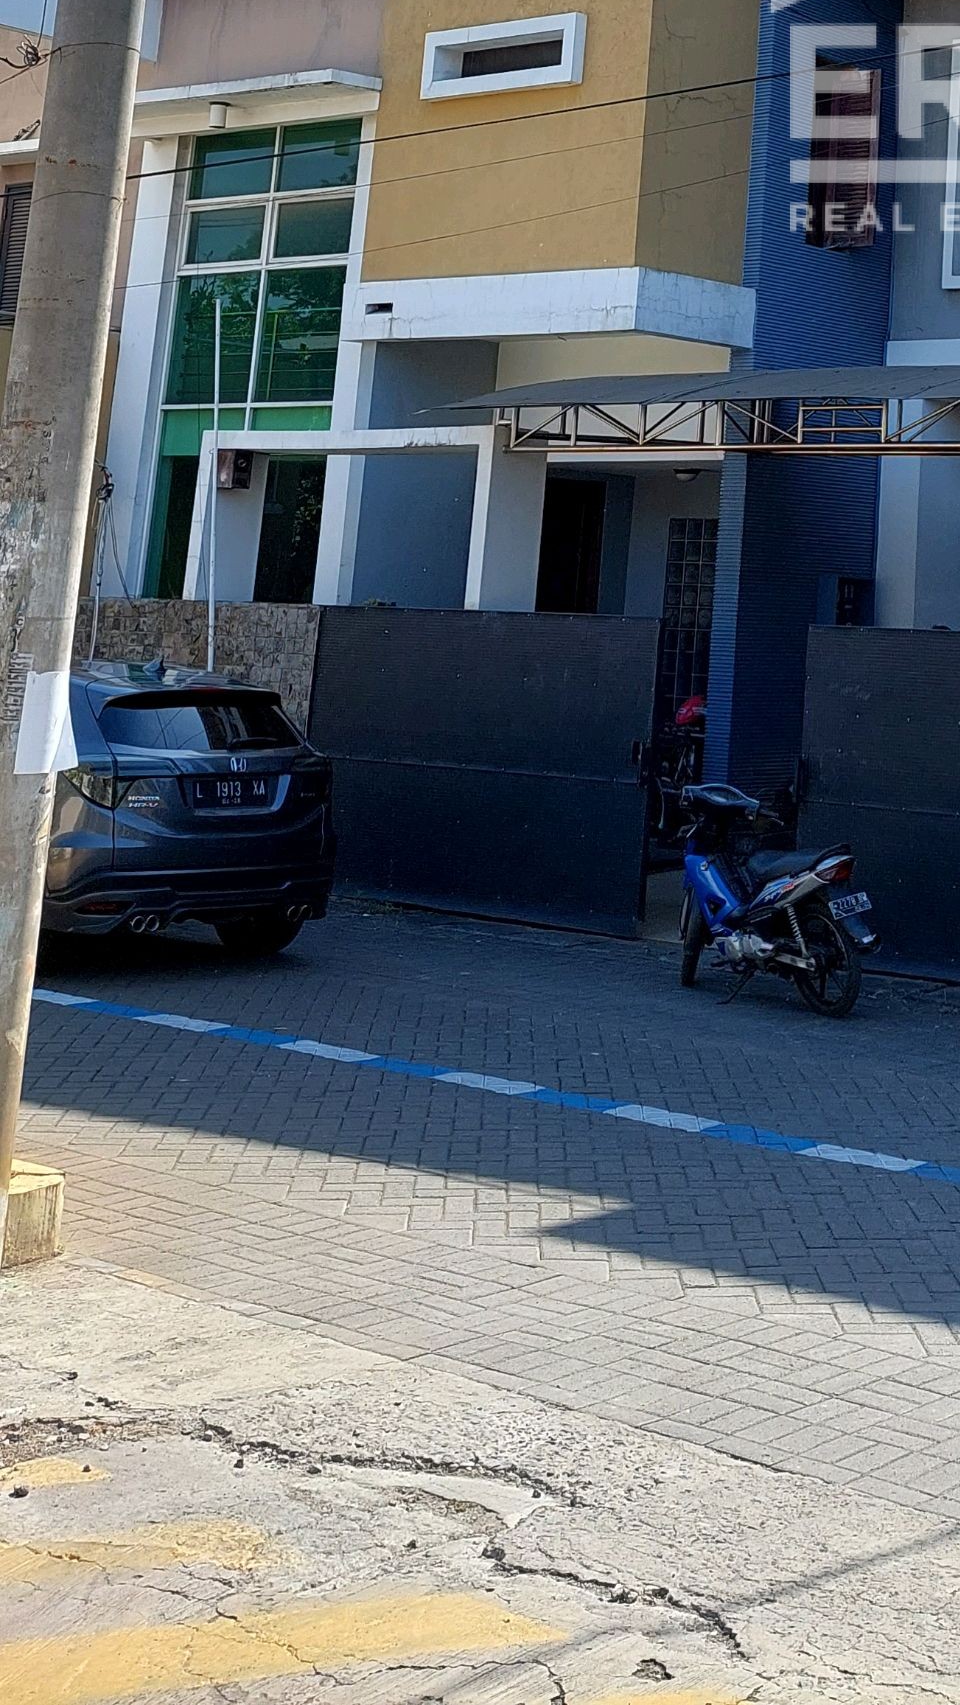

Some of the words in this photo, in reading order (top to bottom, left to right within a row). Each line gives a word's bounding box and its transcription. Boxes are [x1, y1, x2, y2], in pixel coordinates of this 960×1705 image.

[196, 782, 203, 798] L
[216, 781, 242, 797] 1913
[252, 780, 266, 796] XA
